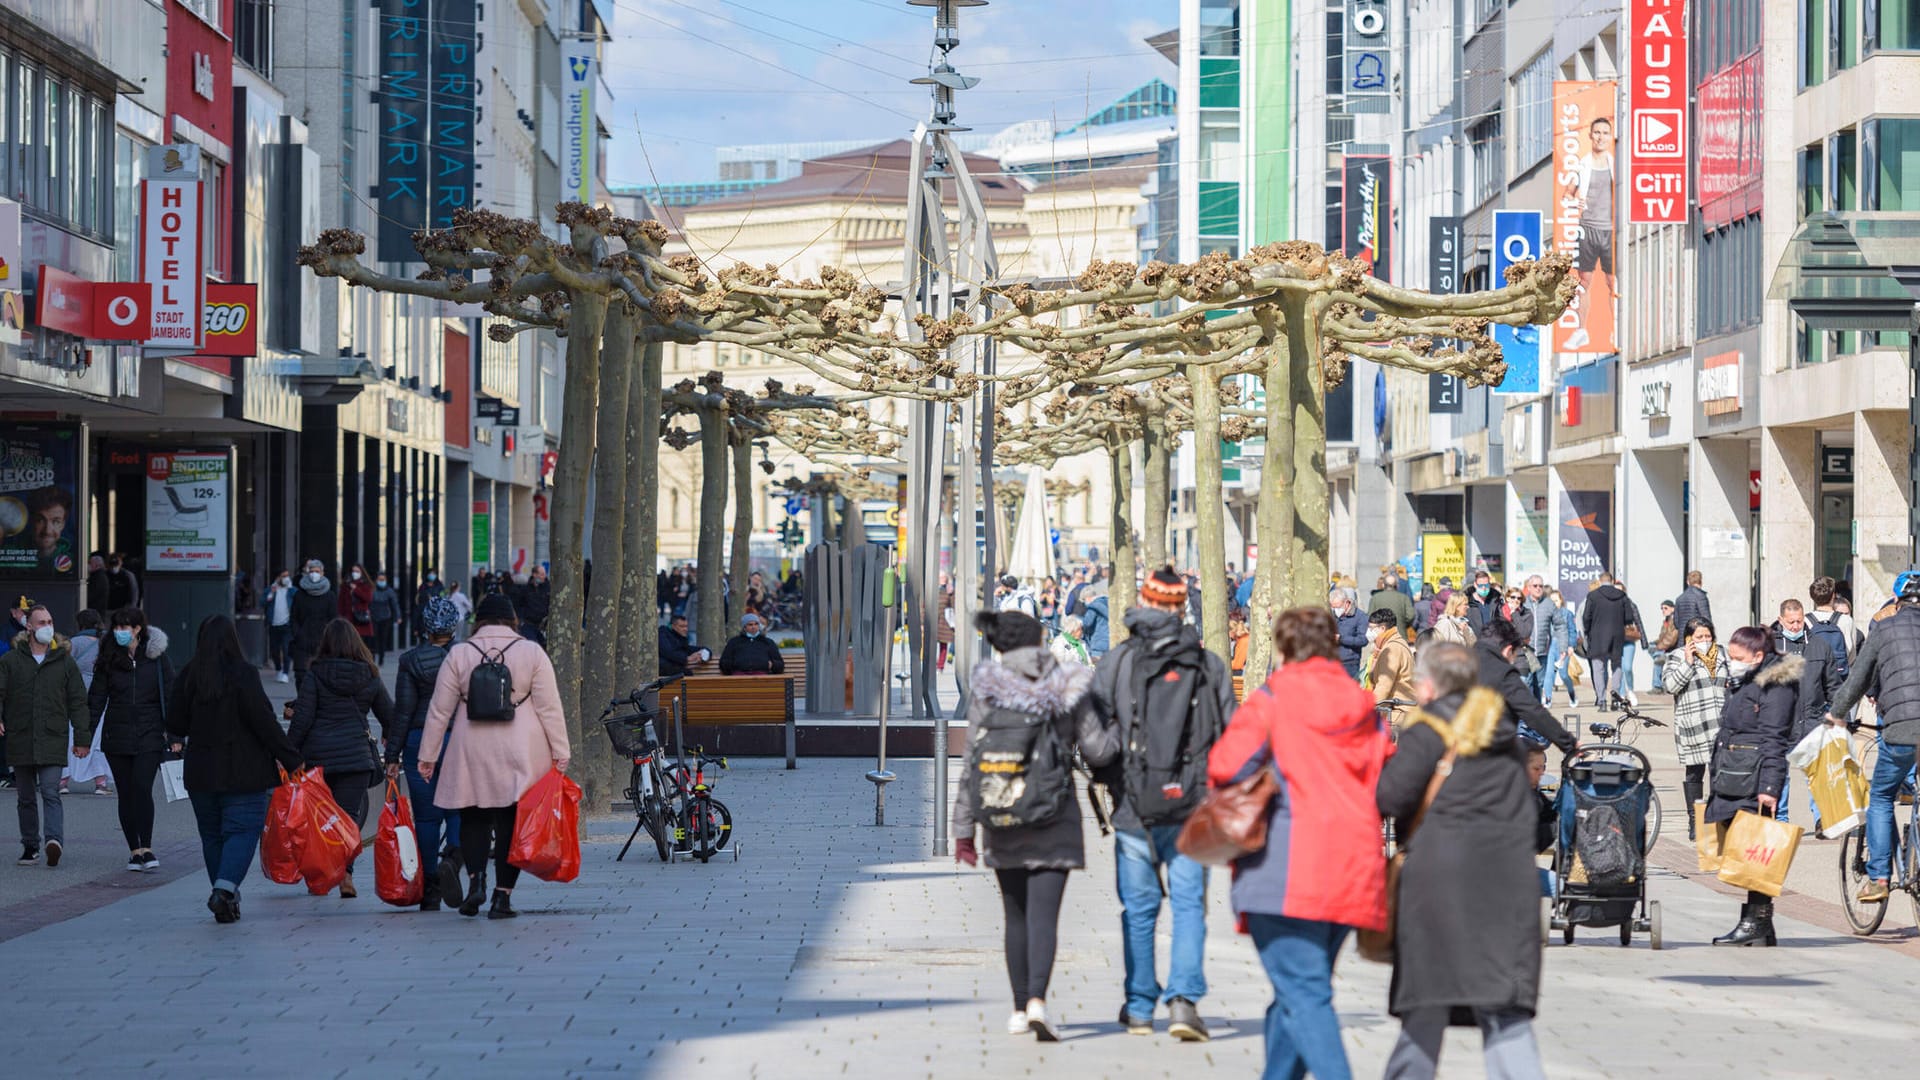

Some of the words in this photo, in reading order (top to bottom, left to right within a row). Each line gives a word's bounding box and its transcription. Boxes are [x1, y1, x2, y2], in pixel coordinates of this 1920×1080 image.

[1559, 103, 1586, 186] Sports
[1641, 143, 1676, 152] RADIO
[1359, 163, 1375, 202] Hut
[1643, 198, 1674, 218] TV
[1358, 202, 1374, 250] Pizza
[161, 187, 182, 305] HOTEL
[155, 312, 184, 324] STADT
[0, 468, 55, 483] EKORD
[172, 461, 224, 472] ENDLICH
[1561, 539, 1589, 554] Day
[1561, 553, 1601, 569] Night
[1744, 844, 1776, 866] H&M
